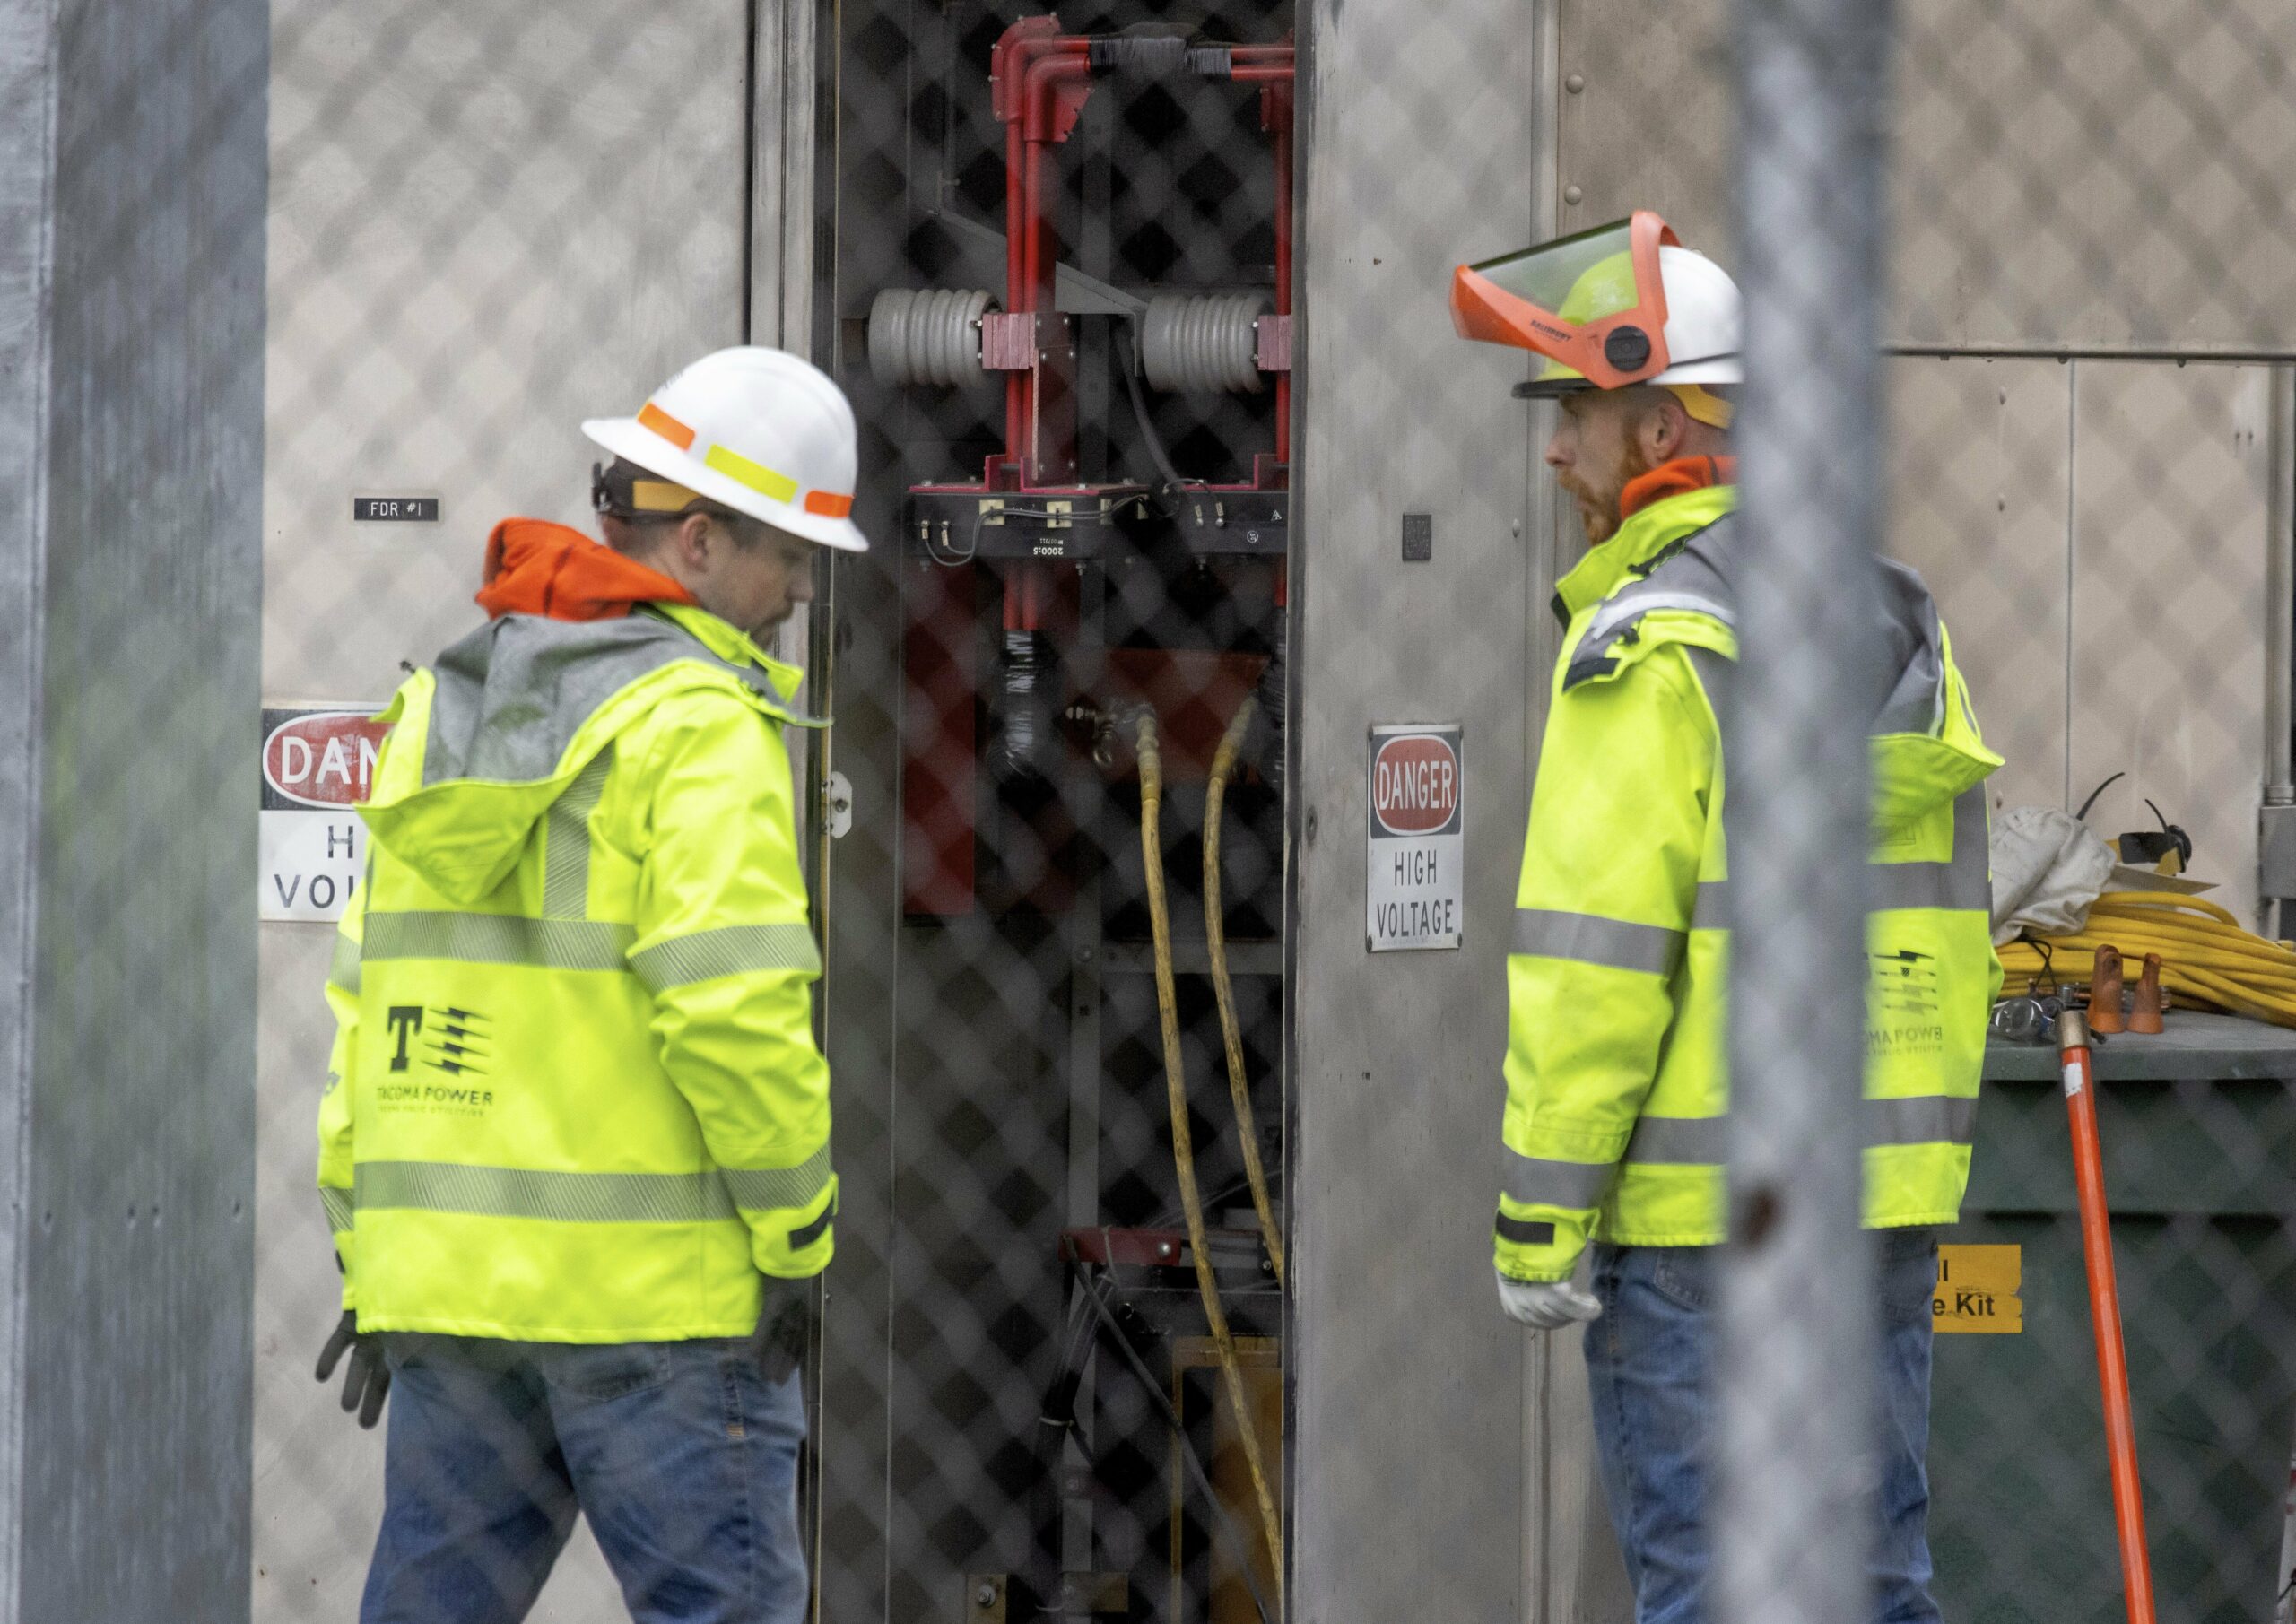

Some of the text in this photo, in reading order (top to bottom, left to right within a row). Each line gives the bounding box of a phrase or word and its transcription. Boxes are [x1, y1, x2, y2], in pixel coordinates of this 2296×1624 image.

[370, 502, 398, 517] FDR
[1033, 546, 1064, 555] 2000:5
[1378, 760, 1452, 811] DANGER
[1394, 849, 1437, 886] HIGH
[1377, 899, 1453, 938] VOLTAGE
[425, 1087, 493, 1105] POWER
[1956, 1292, 1996, 1316] Kit
